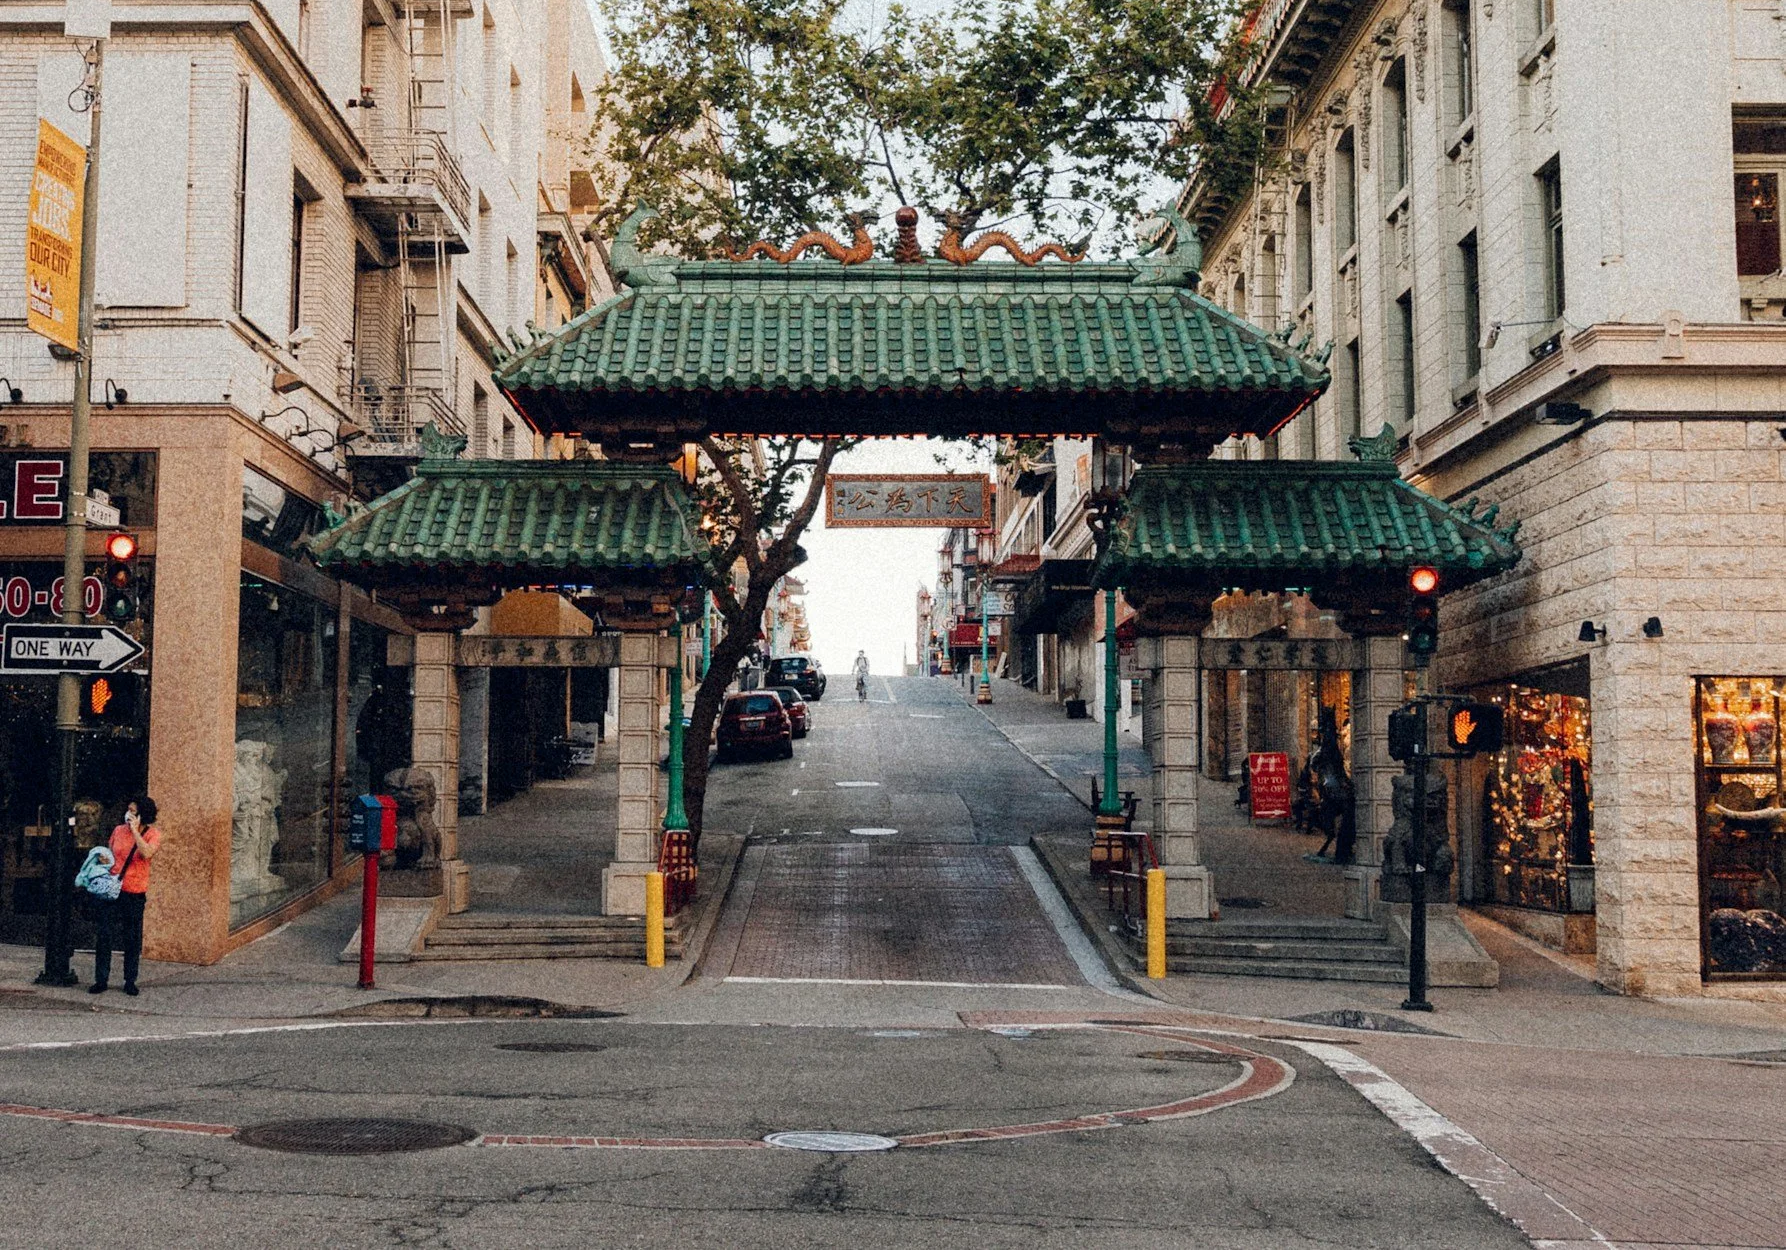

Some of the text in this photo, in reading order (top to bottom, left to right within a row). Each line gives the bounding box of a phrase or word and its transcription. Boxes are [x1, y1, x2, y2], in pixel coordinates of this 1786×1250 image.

[30, 226, 72, 260] TRANSFORMING
[30, 241, 71, 280] OUR CITY.
[0, 460, 63, 519] E
[91, 504, 112, 523] Grant
[15, 639, 95, 657] ONE WAY
[1270, 785, 1287, 793] OFF
